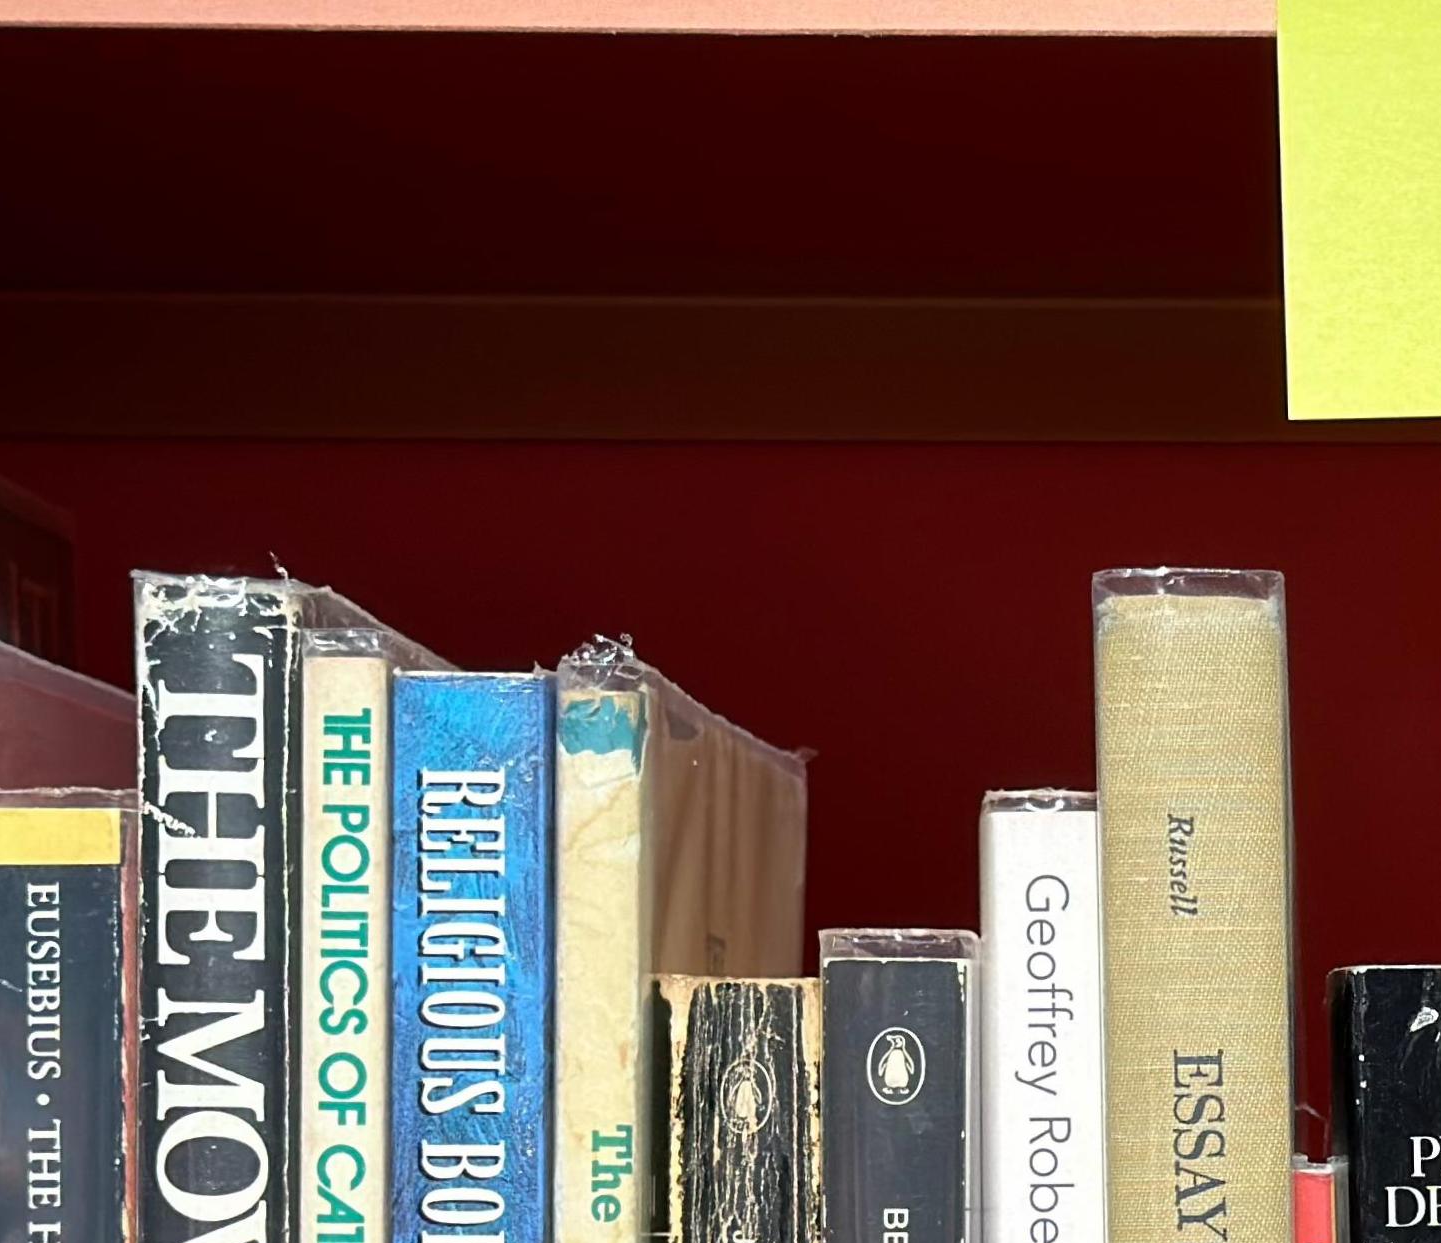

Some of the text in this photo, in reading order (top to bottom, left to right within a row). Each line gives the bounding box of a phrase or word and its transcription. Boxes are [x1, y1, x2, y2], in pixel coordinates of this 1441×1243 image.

[158, 653, 265, 964] THE
[321, 706, 372, 786] THE
[317, 802, 371, 1036] POLITICS
[1168, 814, 1200, 917] Russell
[25, 883, 61, 1080] EUSEBIUS
[418, 766, 508, 1118] RELIGIOUS
[1014, 875, 1073, 1097] Geoffrey
[316, 1051, 369, 1125] OF
[27, 1119, 61, 1209] THE
[591, 1125, 633, 1222] The
